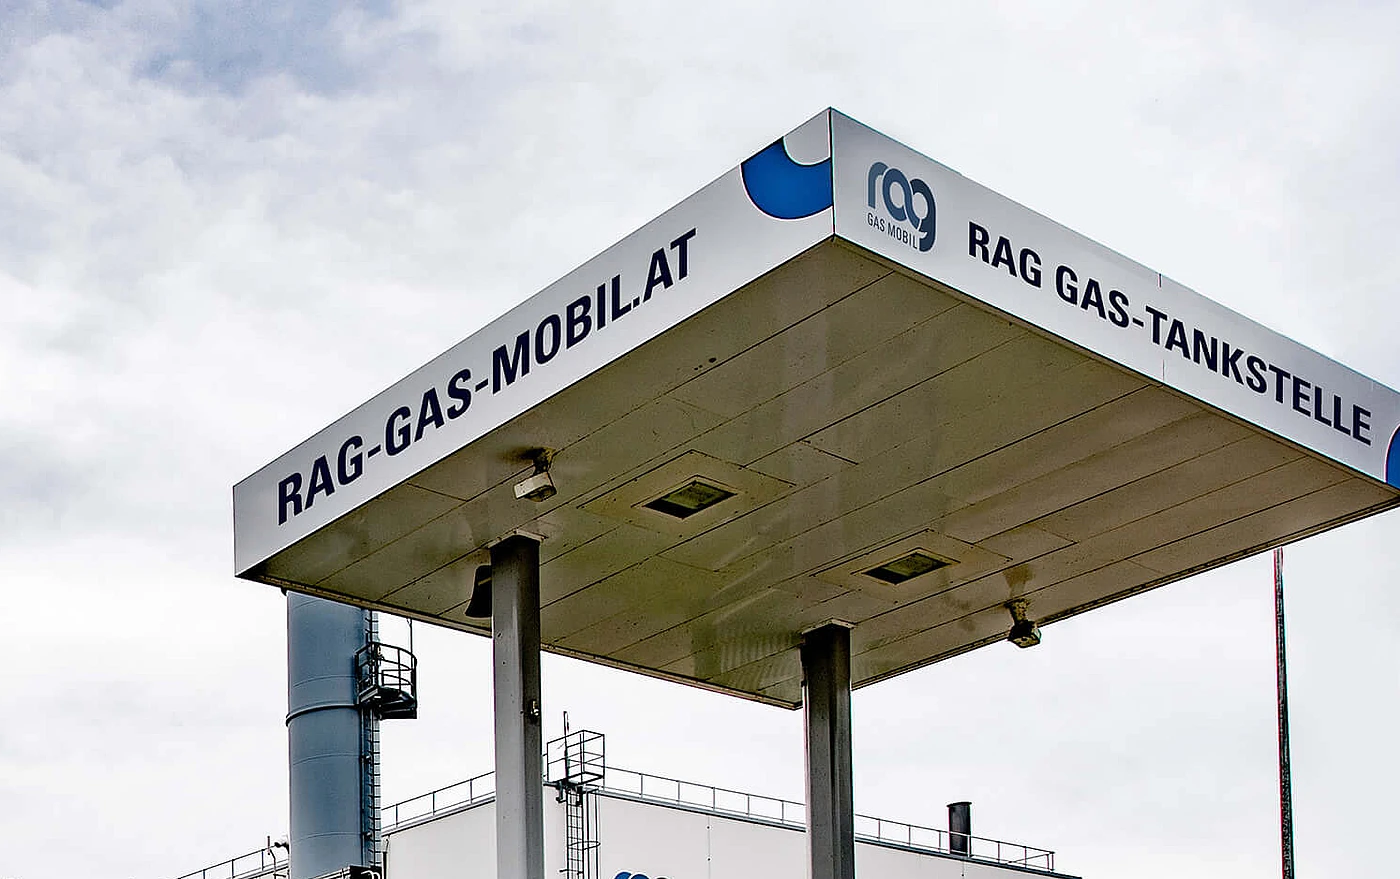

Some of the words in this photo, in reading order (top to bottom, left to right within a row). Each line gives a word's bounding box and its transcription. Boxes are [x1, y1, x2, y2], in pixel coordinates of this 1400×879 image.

[867, 212, 886, 233] GAS
[887, 222, 919, 250] MOBIL
[968, 221, 1043, 288] RAG
[1055, 264, 1373, 446] GAS-TANKSTELLE
[278, 227, 697, 526] RAG-GAS-MOBIL.AT
